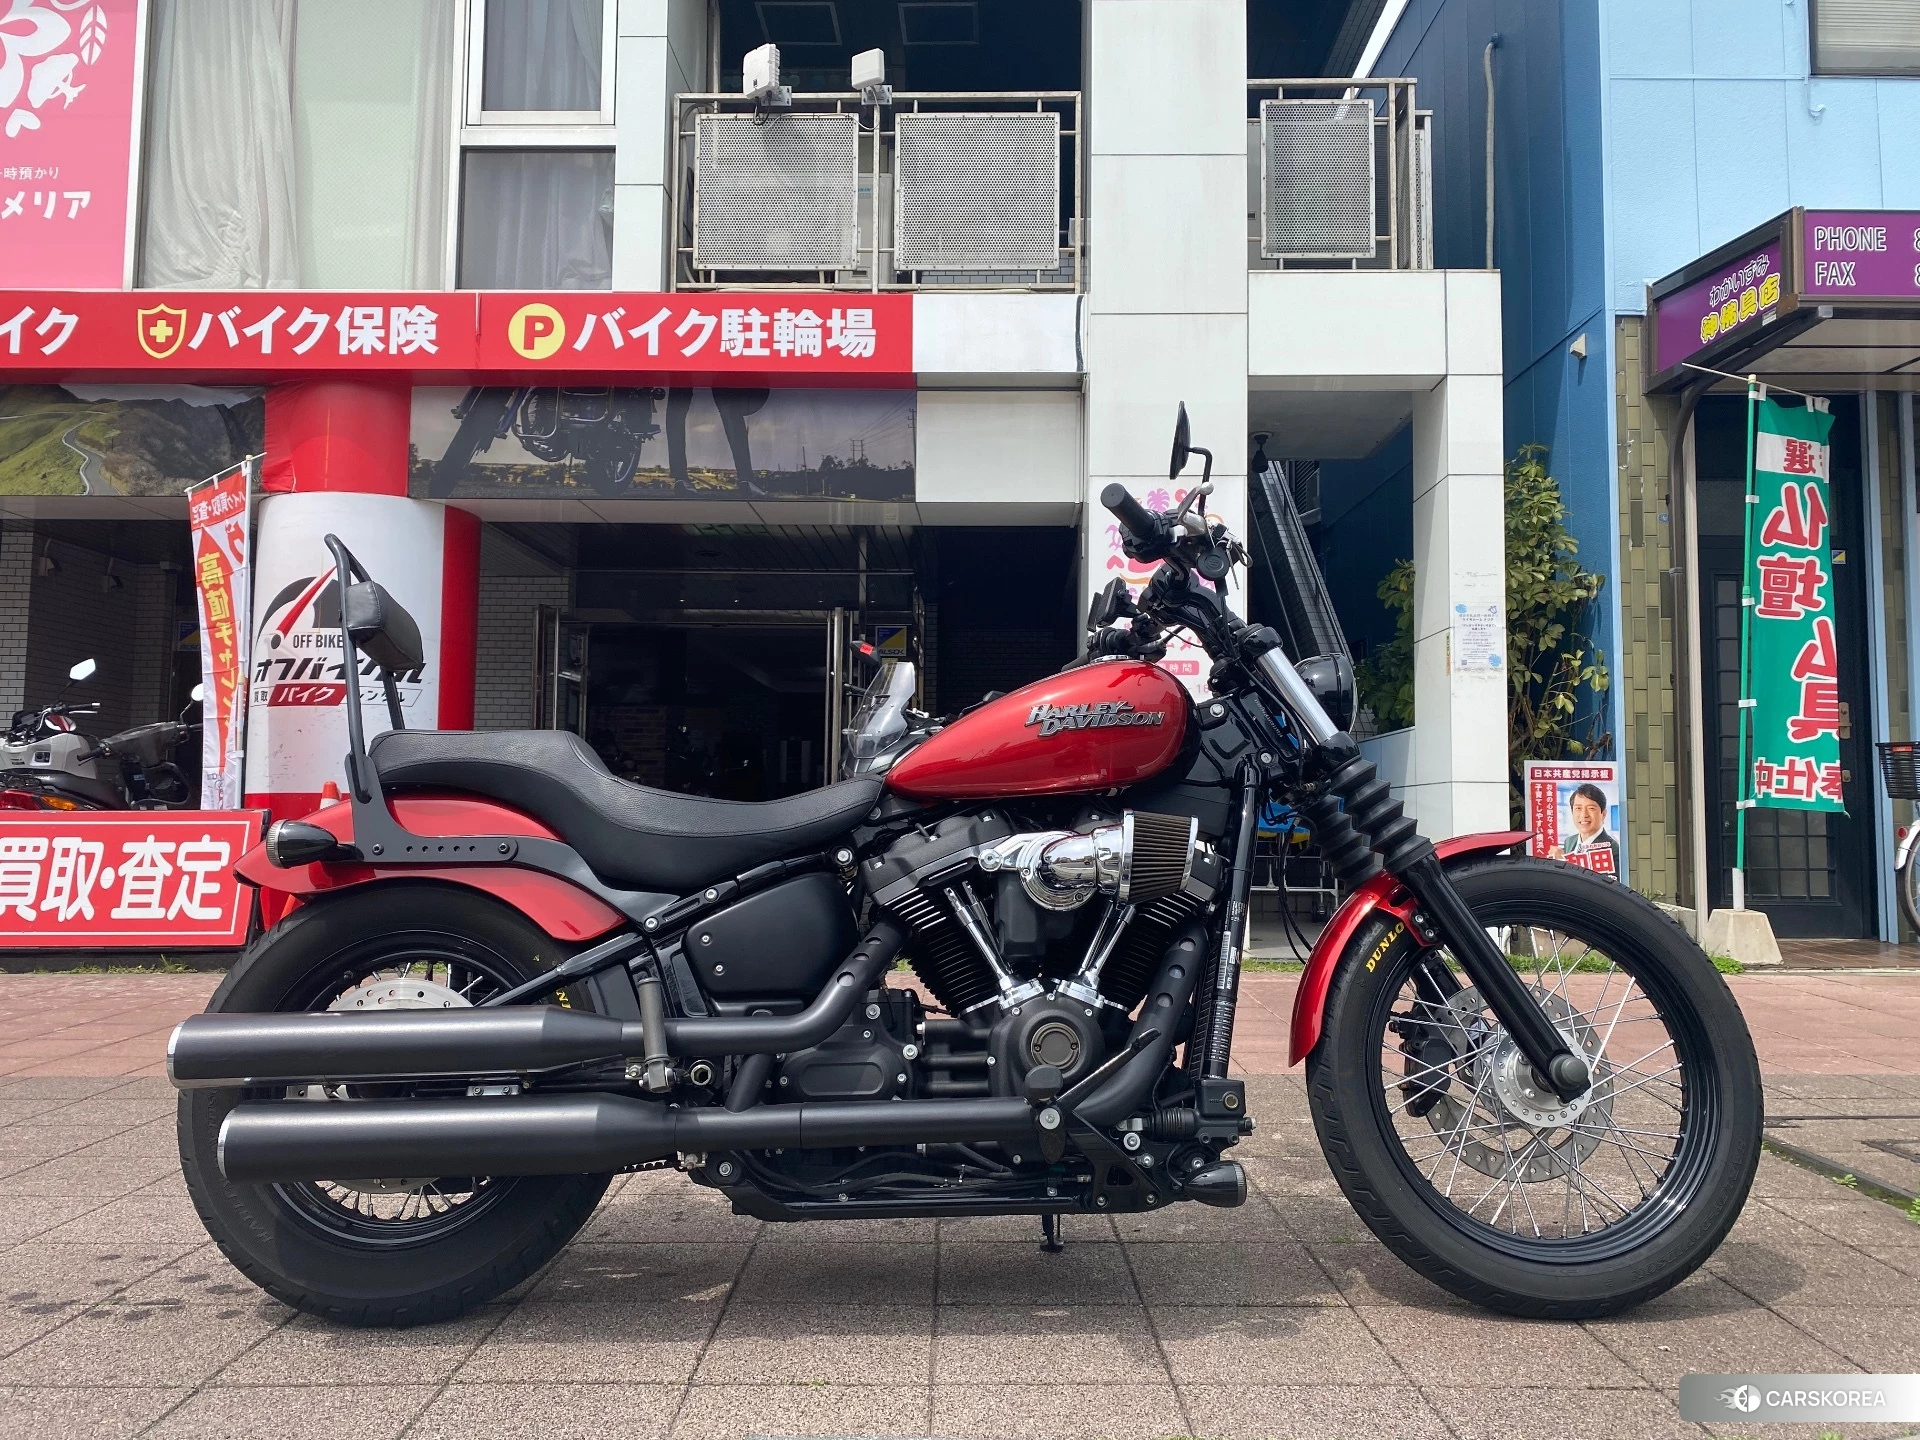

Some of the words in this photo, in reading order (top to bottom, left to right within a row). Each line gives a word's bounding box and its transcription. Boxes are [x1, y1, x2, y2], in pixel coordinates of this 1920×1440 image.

[0, 166, 59, 180] 時預かり
[1, 190, 91, 219] メリア
[1815, 226, 1886, 251] PHONE
[1815, 261, 1856, 286] FAX
[0, 305, 79, 355] イク
[188, 304, 440, 355] バイク保険
[572, 306, 877, 358] バイク駐輪場
[293, 634, 313, 648] OFF
[277, 686, 337, 703] バイク
[1037, 712, 1165, 738] DAVIDSON
[1534, 769, 1609, 779] 日本共産党掲示板
[0, 834, 231, 922] 買取・査定
